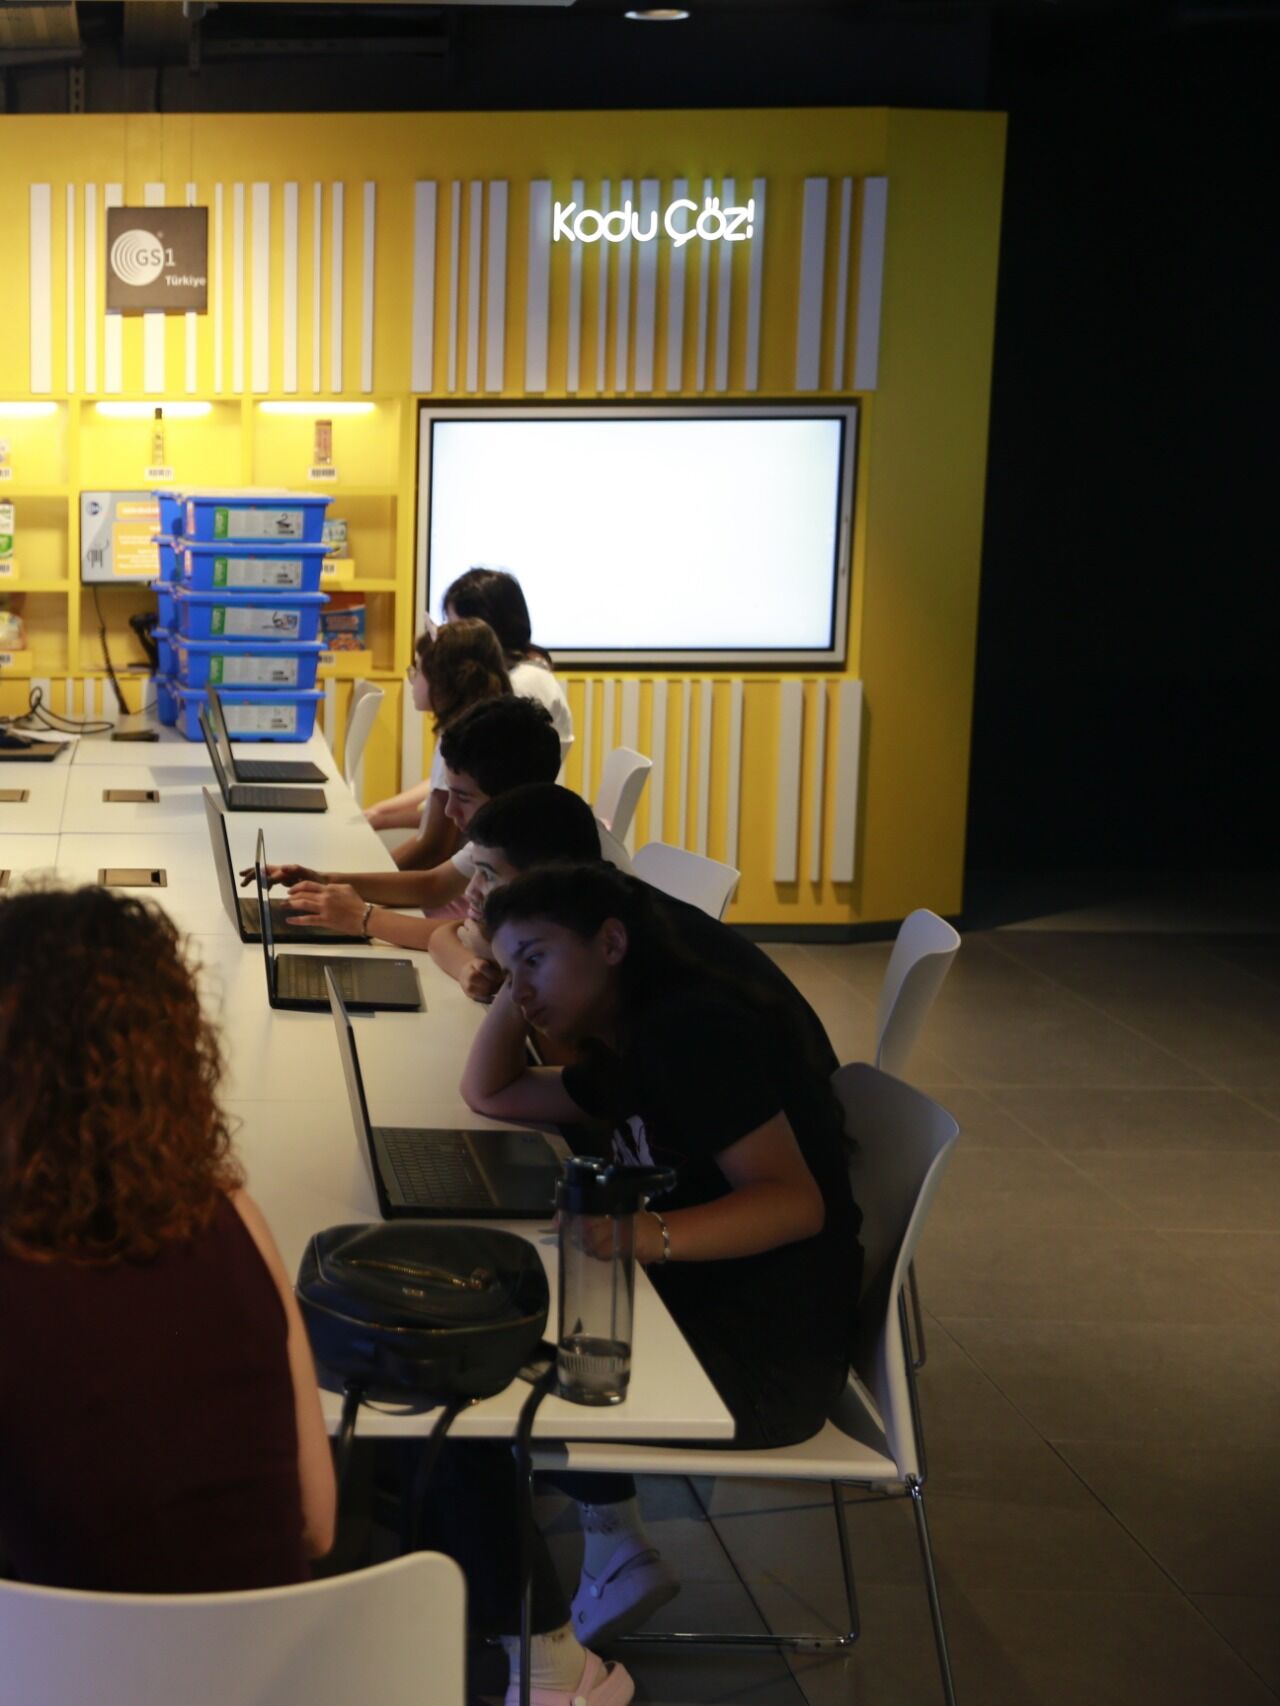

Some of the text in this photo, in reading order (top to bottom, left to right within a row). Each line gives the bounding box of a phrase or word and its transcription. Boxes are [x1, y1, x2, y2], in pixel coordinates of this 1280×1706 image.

[553, 196, 756, 248] Kodu Çöz!
[135, 247, 176, 267] GS1
[165, 274, 207, 288] Türkiye
